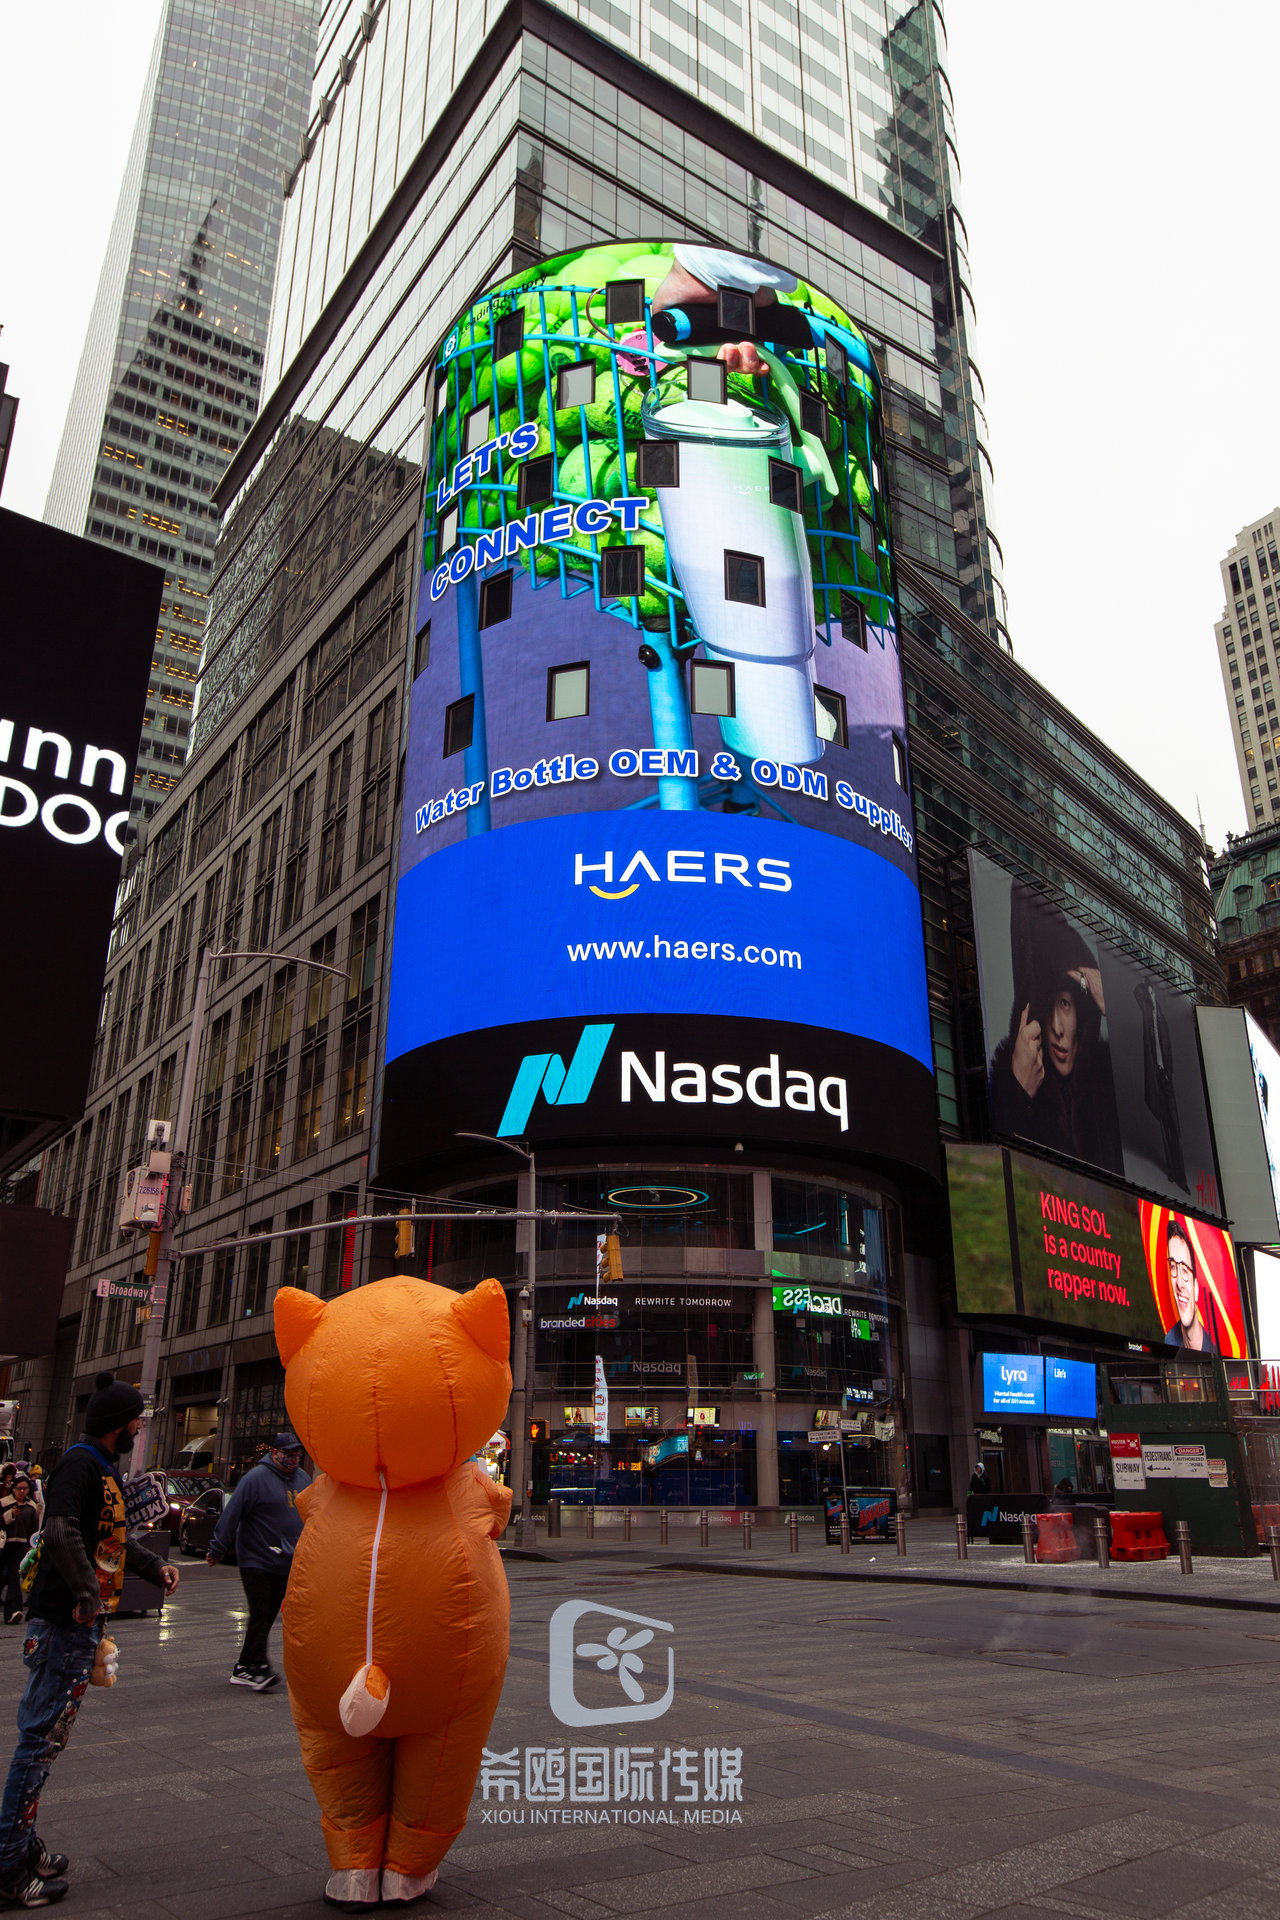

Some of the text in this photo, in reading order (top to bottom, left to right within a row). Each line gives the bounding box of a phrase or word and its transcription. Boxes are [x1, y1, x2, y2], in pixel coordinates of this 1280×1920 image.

[460, 298, 500, 335] Leading
[436, 422, 538, 513] LET'S
[430, 496, 650, 602] CONNECT
[415, 748, 913, 854] Water Bottle OEM & ODM Supplier
[574, 850, 793, 893] HAERS
[567, 935, 802, 970] www.haers.com
[620, 1050, 850, 1132] Nasdaq
[1040, 1191, 1111, 1240] KING SOL
[1043, 1225, 1121, 1279] is a country
[109, 1283, 149, 1301] Broadway
[584, 1295, 732, 1307] Nasdaq REWRITE TOMORROW
[1047, 1268, 1130, 1307] rapper now.
[632, 1360, 681, 1375] Nasdaq
[1115, 1462, 1140, 1473] SUBWAY
[1144, 1451, 1172, 1461] PEDESTRIANS
[859, 1499, 890, 1529] AMAZE
